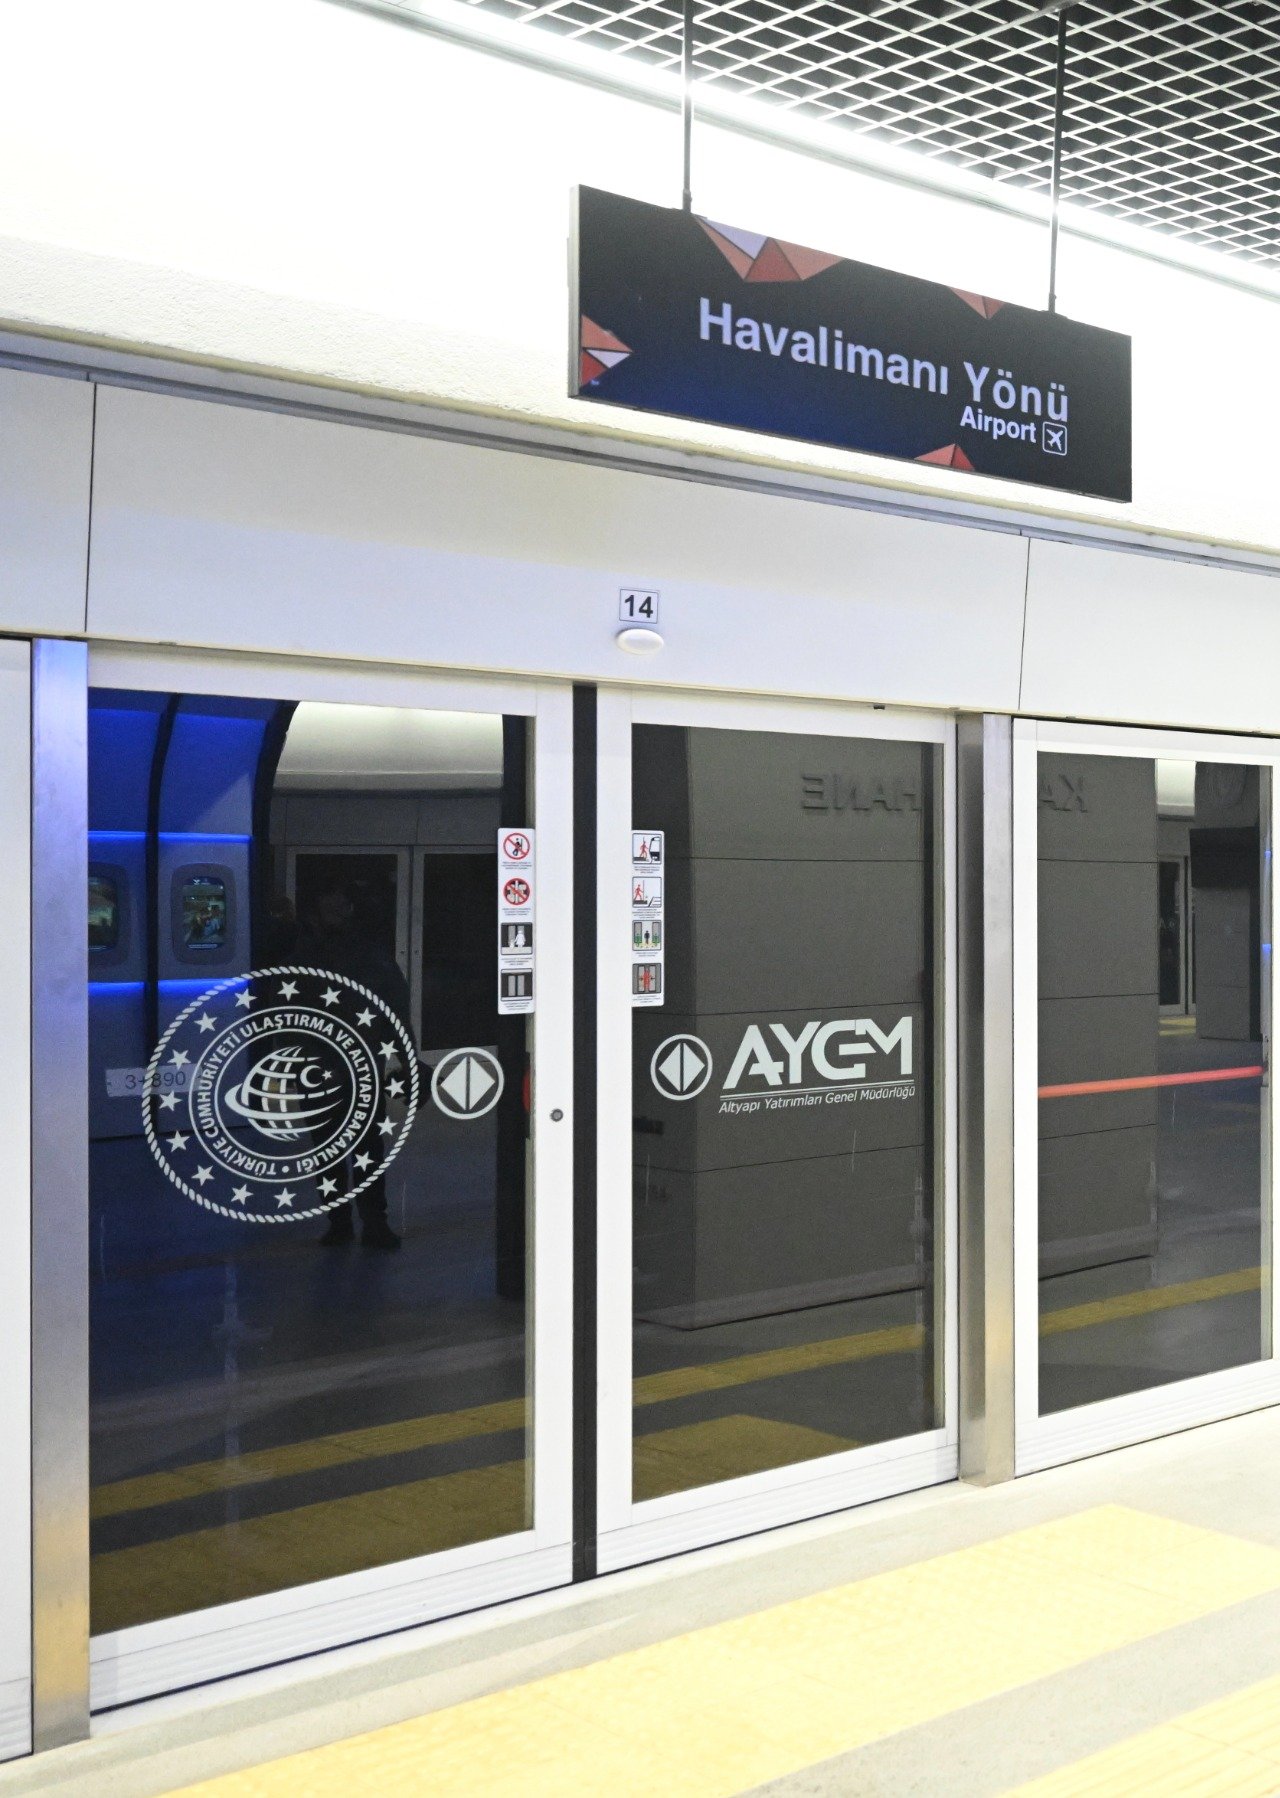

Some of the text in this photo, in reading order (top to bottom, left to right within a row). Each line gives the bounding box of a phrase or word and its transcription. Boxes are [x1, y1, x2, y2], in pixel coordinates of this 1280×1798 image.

[700, 297, 1069, 423] Havalimanı Yönü
[960, 405, 1037, 443] Airport
[624, 594, 654, 619] 14
[722, 1016, 913, 1090] AYGM
[197, 1013, 372, 1177] TÜRKİYE CUMHURİYETİ ULAŞTIRMA VE ALTYAPI BAKANLIĞI
[719, 1085, 916, 1114] Altyapı Yatırımları Genel Müdürlüğü
